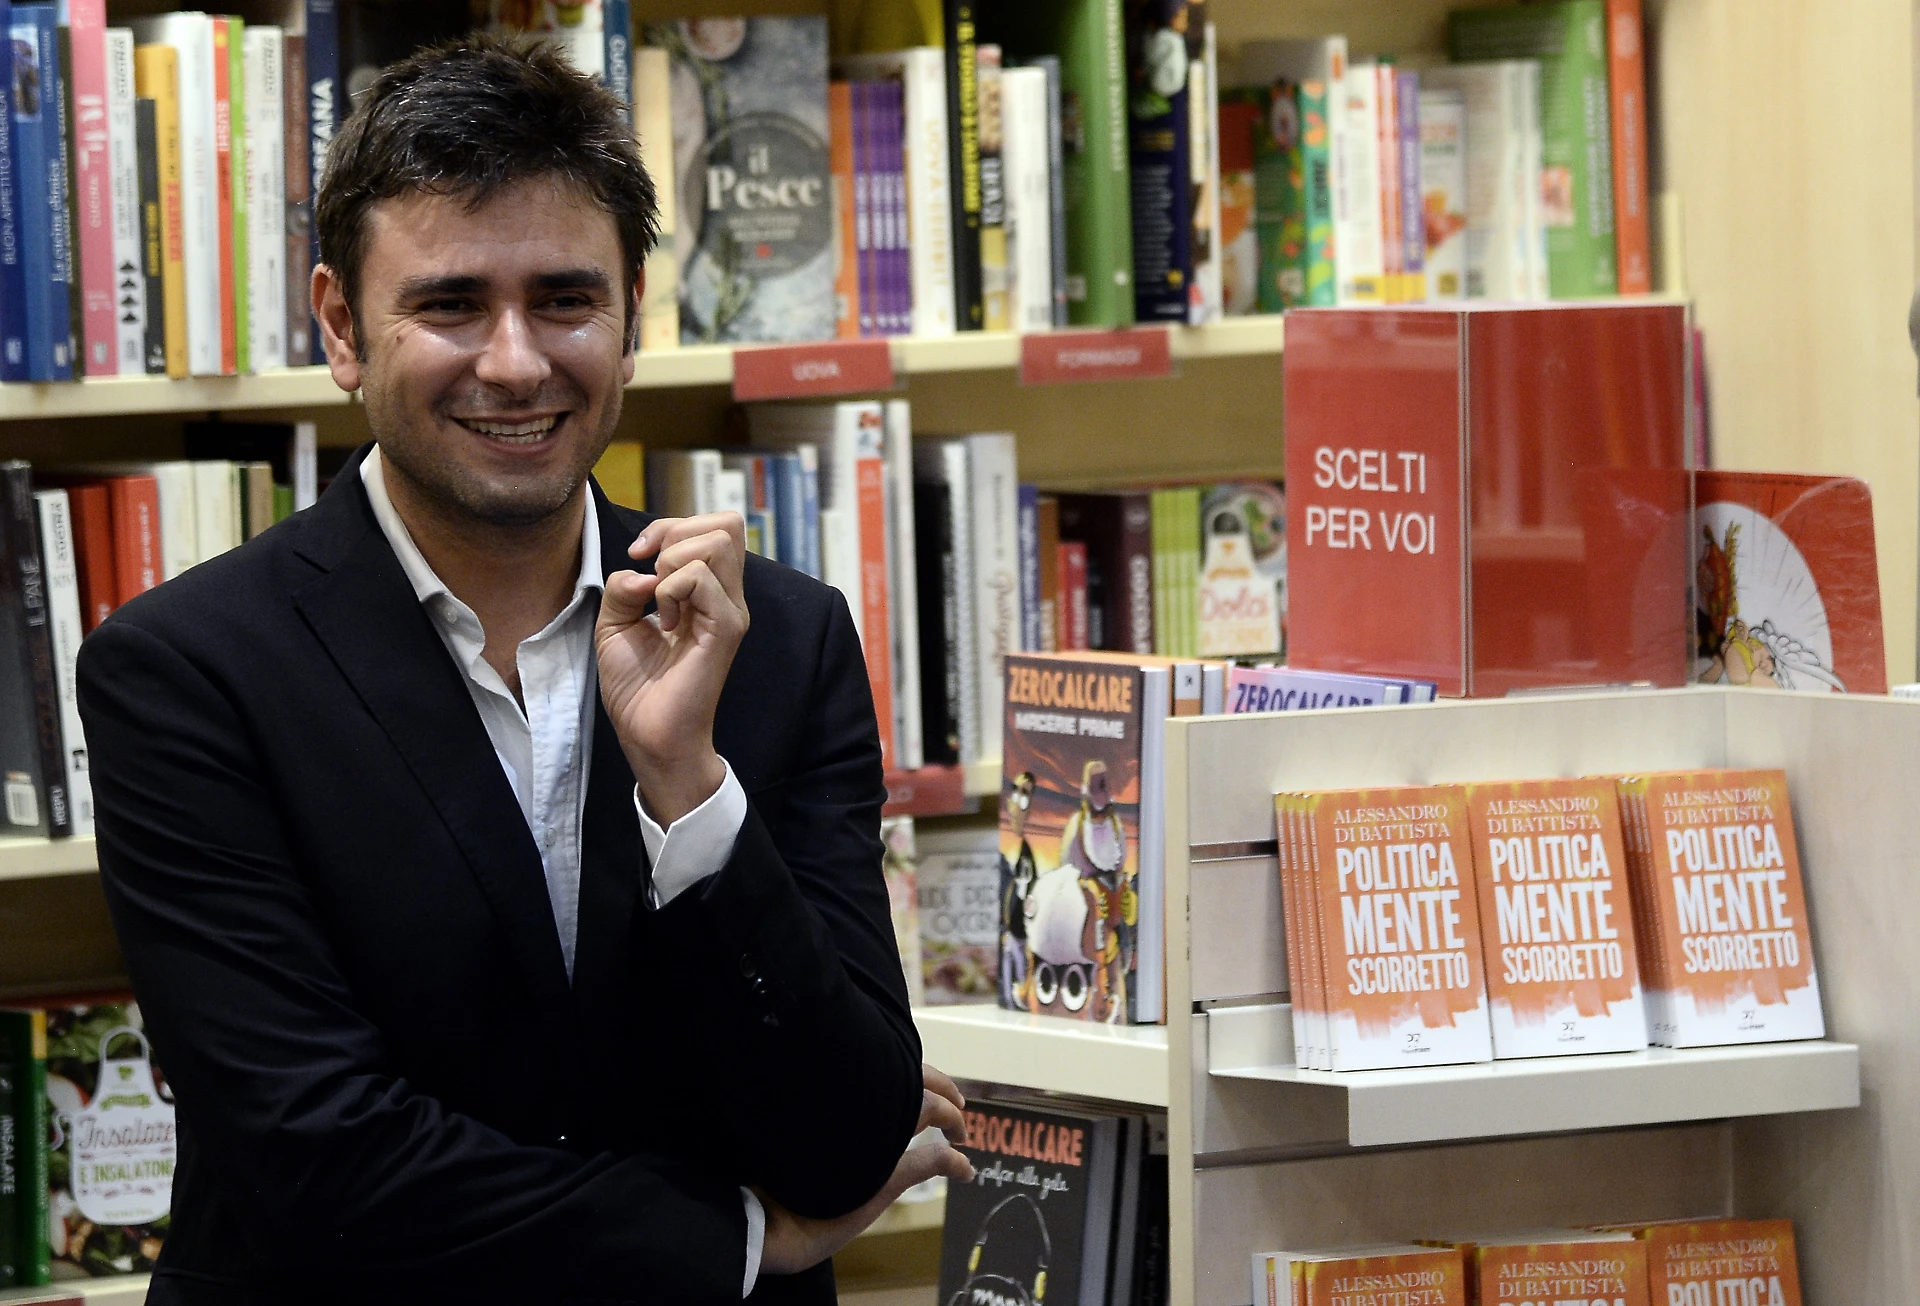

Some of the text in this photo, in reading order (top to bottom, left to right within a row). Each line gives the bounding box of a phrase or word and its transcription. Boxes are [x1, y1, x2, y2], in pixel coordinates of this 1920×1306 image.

[216, 100, 231, 151] SUSHI
[748, 146, 769, 176] il
[0, 154, 13, 221] APPETITO
[706, 166, 822, 211] Pesce
[2, 224, 16, 265] BUON
[1314, 446, 1426, 494] SCELTI
[1305, 505, 1436, 555] PER VOI
[21, 559, 43, 607] PANE
[1008, 666, 1133, 713] ZEROCALCARE
[1234, 683, 1373, 714] ZEROCA
[1079, 717, 1124, 739] PRIME
[1334, 804, 1448, 825] ALESSANDRO
[1487, 797, 1599, 816] ALESSANDRO
[1663, 787, 1771, 807] ALESSANDRO
[1664, 805, 1774, 825] DI BATTISTA
[1335, 822, 1451, 843] DI BATTISTA
[1488, 814, 1602, 834] DI BATTISTA
[1336, 841, 1459, 893] POLITICA
[1489, 833, 1611, 883] POLITICA
[1666, 823, 1784, 873] POLITICA
[1340, 889, 1466, 956] MENTE
[1494, 880, 1618, 945] MENTE
[1672, 869, 1793, 935] MENTE
[1502, 941, 1623, 985] SCORRETTO
[1682, 930, 1800, 974] SCORRETTO
[1347, 951, 1470, 996] SCORRETTO
[960, 1109, 1083, 1167] EROCALCARE
[80, 1166, 86, 1184] E
[1664, 1237, 1778, 1259] ALESSANDRO
[1666, 1255, 1779, 1278] DI BATTISTA
[1331, 1271, 1445, 1294] ALESSANDRO
[1498, 1260, 1626, 1279] ALESSANDRO
[1499, 1278, 1627, 1297] DI BATTISTA
[1355, 1289, 1446, 1306] BATTISTA
[1667, 1276, 1787, 1306] POLITICA
